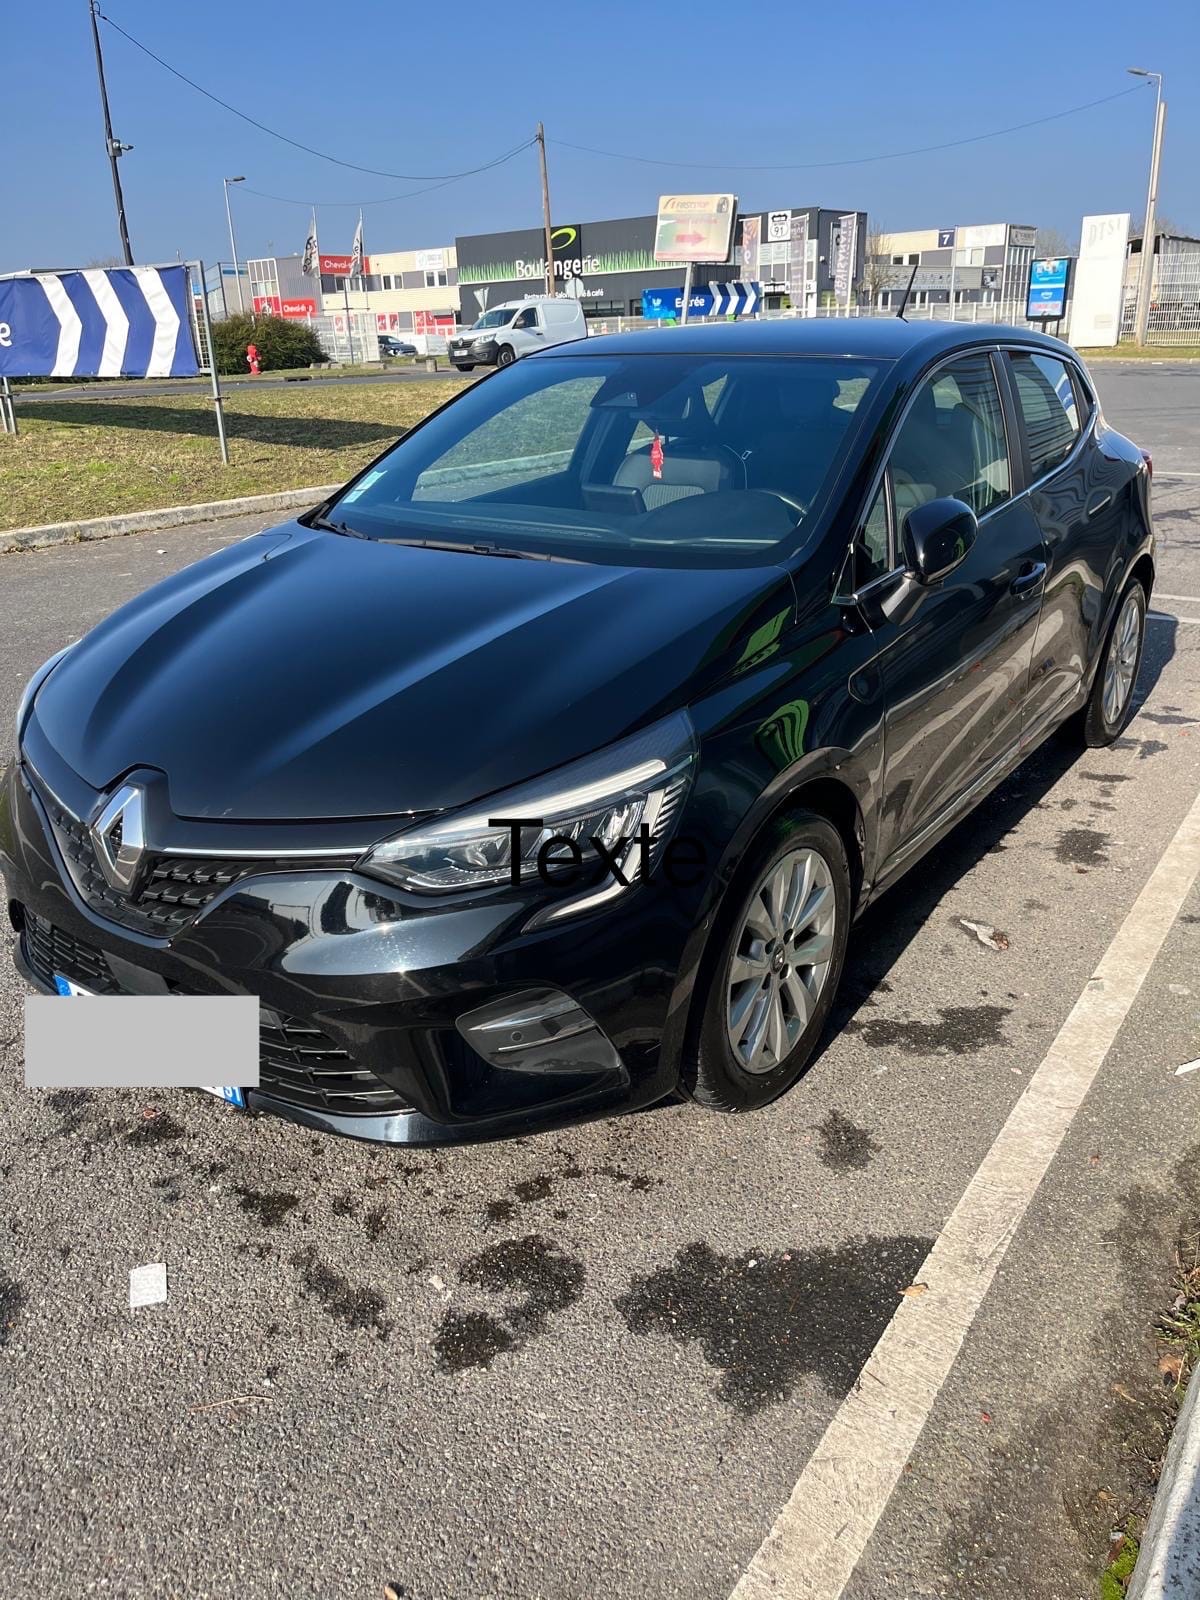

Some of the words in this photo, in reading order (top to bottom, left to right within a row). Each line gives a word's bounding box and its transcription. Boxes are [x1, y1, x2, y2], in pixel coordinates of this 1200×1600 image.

[942, 234, 951, 246] 7
[515, 255, 601, 280] Boulangerie
[675, 296, 705, 308] Erée
